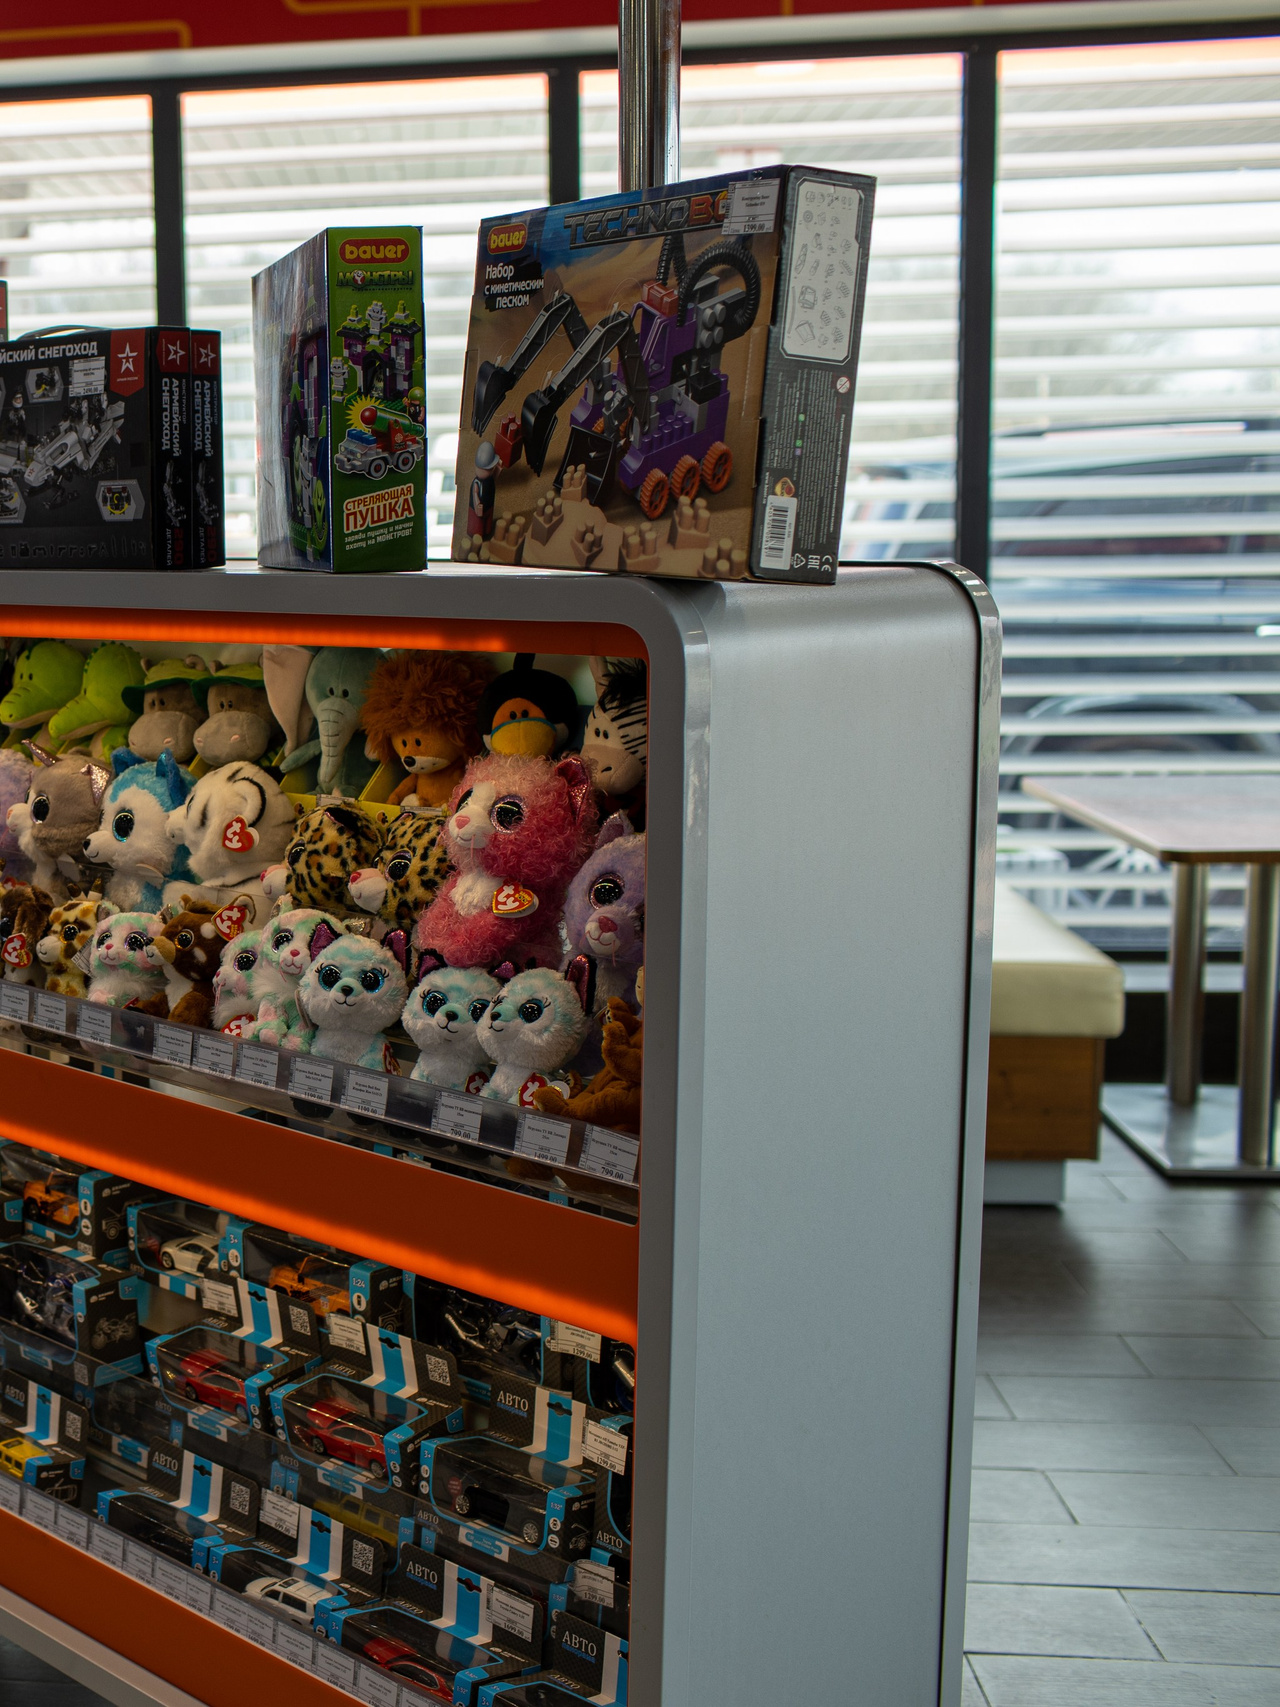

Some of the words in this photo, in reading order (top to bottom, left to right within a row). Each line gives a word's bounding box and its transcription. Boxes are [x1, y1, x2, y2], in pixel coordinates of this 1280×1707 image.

[490, 229, 525, 249] bauer
[345, 244, 406, 259] bauer
[486, 265, 514, 281] Набор
[491, 278, 545, 294] кинетическим
[496, 294, 530, 309] песком
[38, 341, 98, 359] СНЕГОХОД
[162, 378, 171, 450] СНЕГОХОД
[172, 378, 182, 457] АРМЕЙСКИЙ
[194, 380, 202, 451] СНЕГОХОД
[203, 380, 214, 457] АРМЕЙСКИЙ
[345, 485, 412, 511] СТРЕЛЯЮЩАЯ
[345, 498, 413, 532] ПУШКА
[345, 540, 366, 550] охоту
[376, 528, 412, 543] МОНСТРОВ!
[367, 528, 388, 538] пушку
[394, 521, 413, 530] начни
[224, 817, 245, 848] ty
[496, 885, 520, 911] ty
[219, 907, 239, 936] ty
[6, 937, 22, 962] ty
[450, 1128, 471, 1140] 799.00
[601, 1167, 624, 1181] 799.00
[352, 1277, 366, 1288] 1:24
[572, 1347, 593, 1360] 1299.00
[5, 1384, 26, 1403] АВТО
[497, 1390, 529, 1412] АВТО
[152, 1451, 179, 1471] АВТО
[424, 1450, 431, 1459] 3+
[597, 1456, 617, 1470] 1299.00
[417, 1510, 439, 1525] АВТО
[596, 1530, 623, 1549] АВТО
[406, 1561, 438, 1584] АВТО
[584, 1592, 605, 1604] 1299.00
[331, 1620, 340, 1631] 3+
[503, 1622, 525, 1638] 1699.00
[562, 1630, 597, 1657] АВТО
[481, 1696, 490, 1706] 3+
